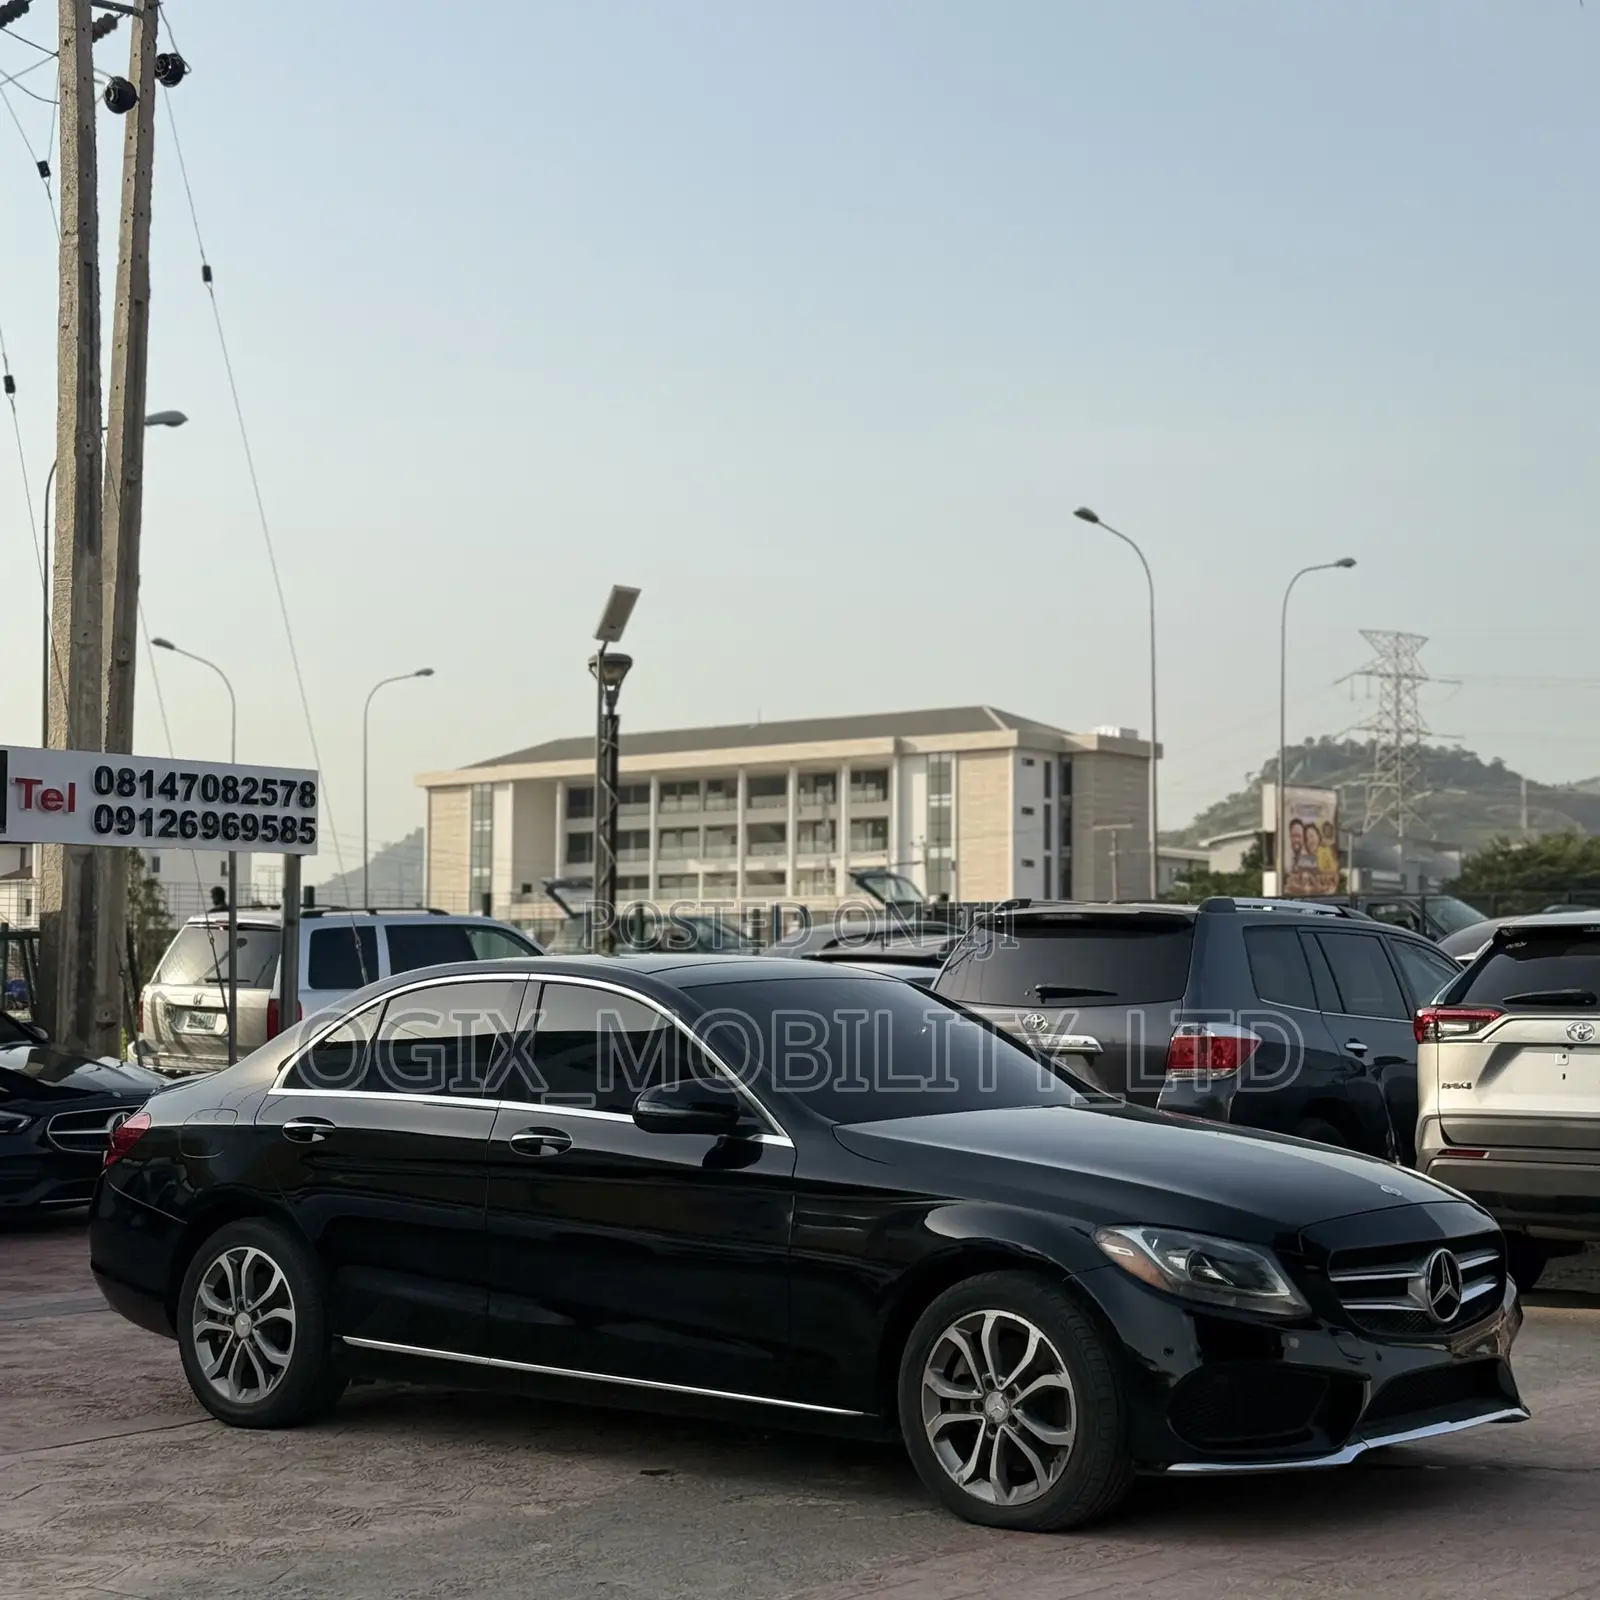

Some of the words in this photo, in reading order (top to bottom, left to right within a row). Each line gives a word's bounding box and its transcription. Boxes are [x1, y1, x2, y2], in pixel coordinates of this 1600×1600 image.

[14, 777, 76, 813] Tel
[93, 765, 317, 809] 08147082578
[93, 804, 317, 845] 09126969585
